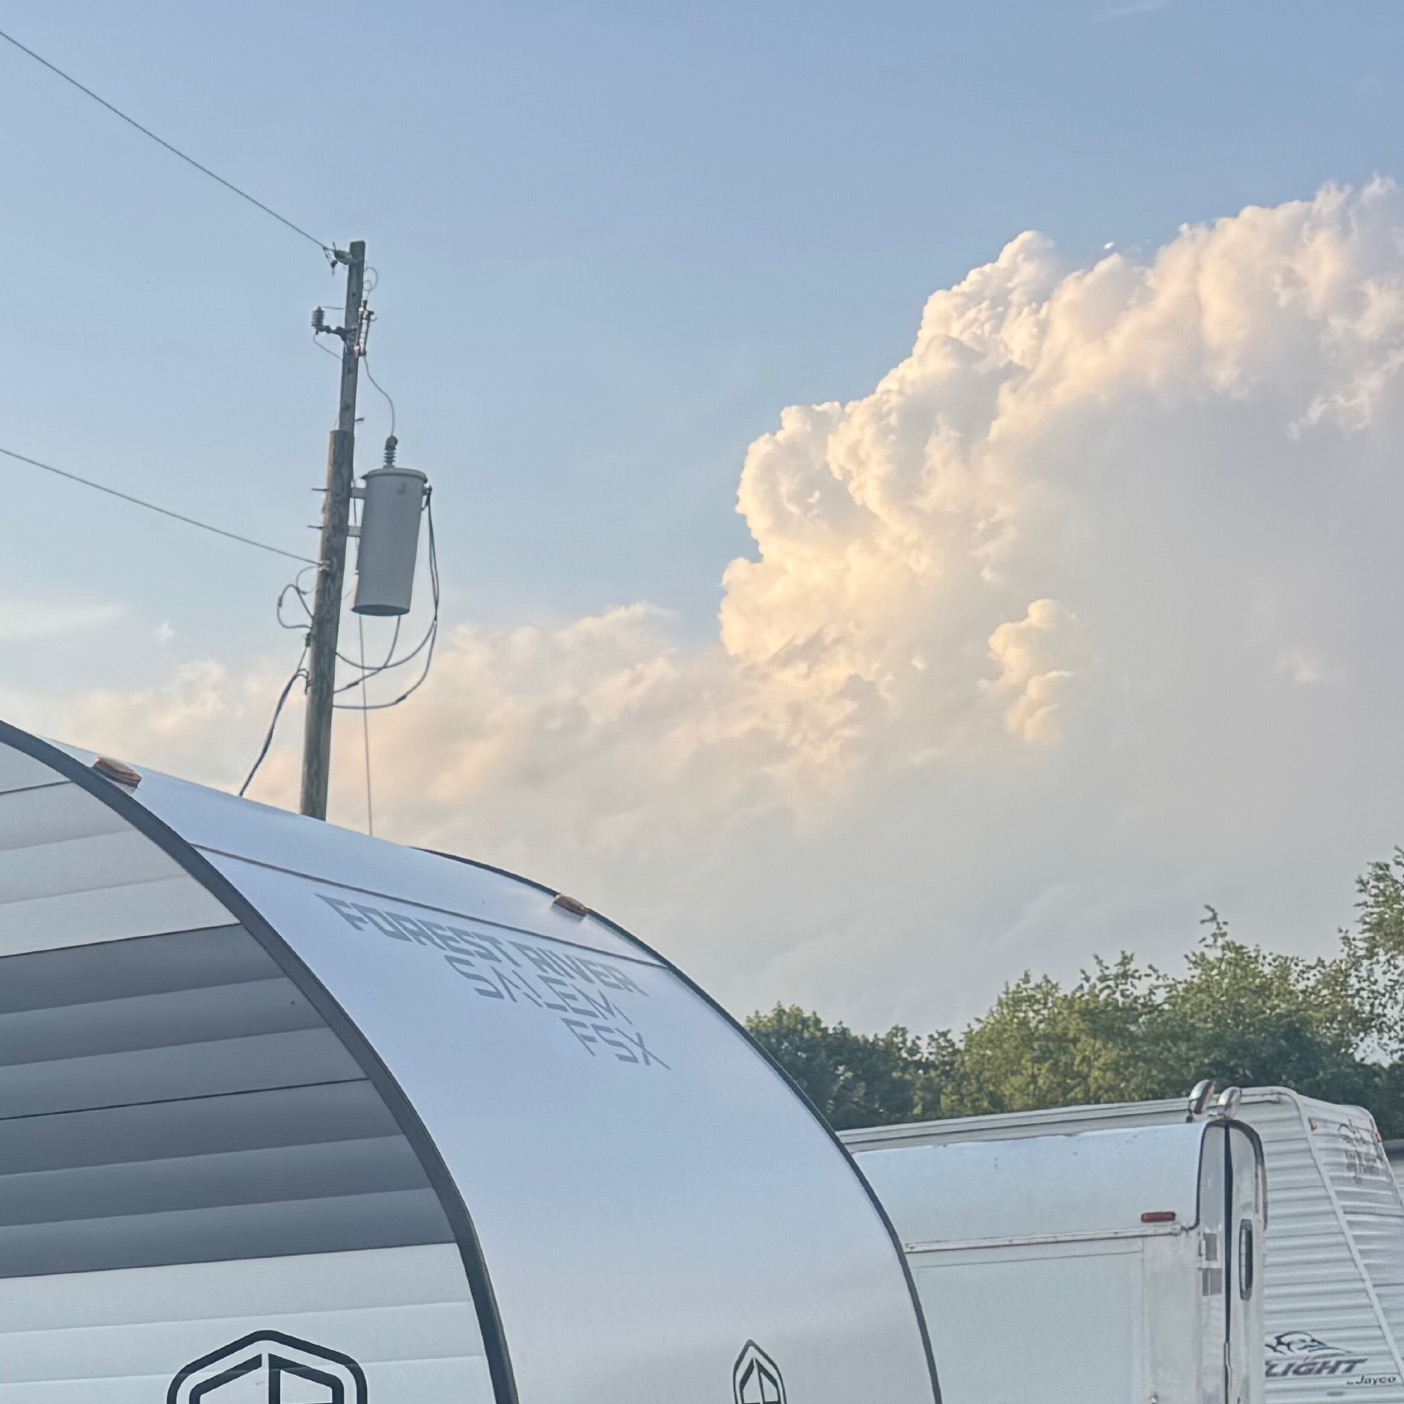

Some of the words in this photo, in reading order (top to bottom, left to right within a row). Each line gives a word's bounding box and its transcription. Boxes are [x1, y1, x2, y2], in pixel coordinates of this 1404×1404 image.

[313, 893, 521, 968] FOREST
[506, 939, 650, 998] RIVER
[443, 954, 634, 1025] SALEM
[559, 1017, 672, 1071] FSX
[1265, 1357, 1369, 1378] LIGHT
[1355, 1374, 1397, 1386] Jayco
